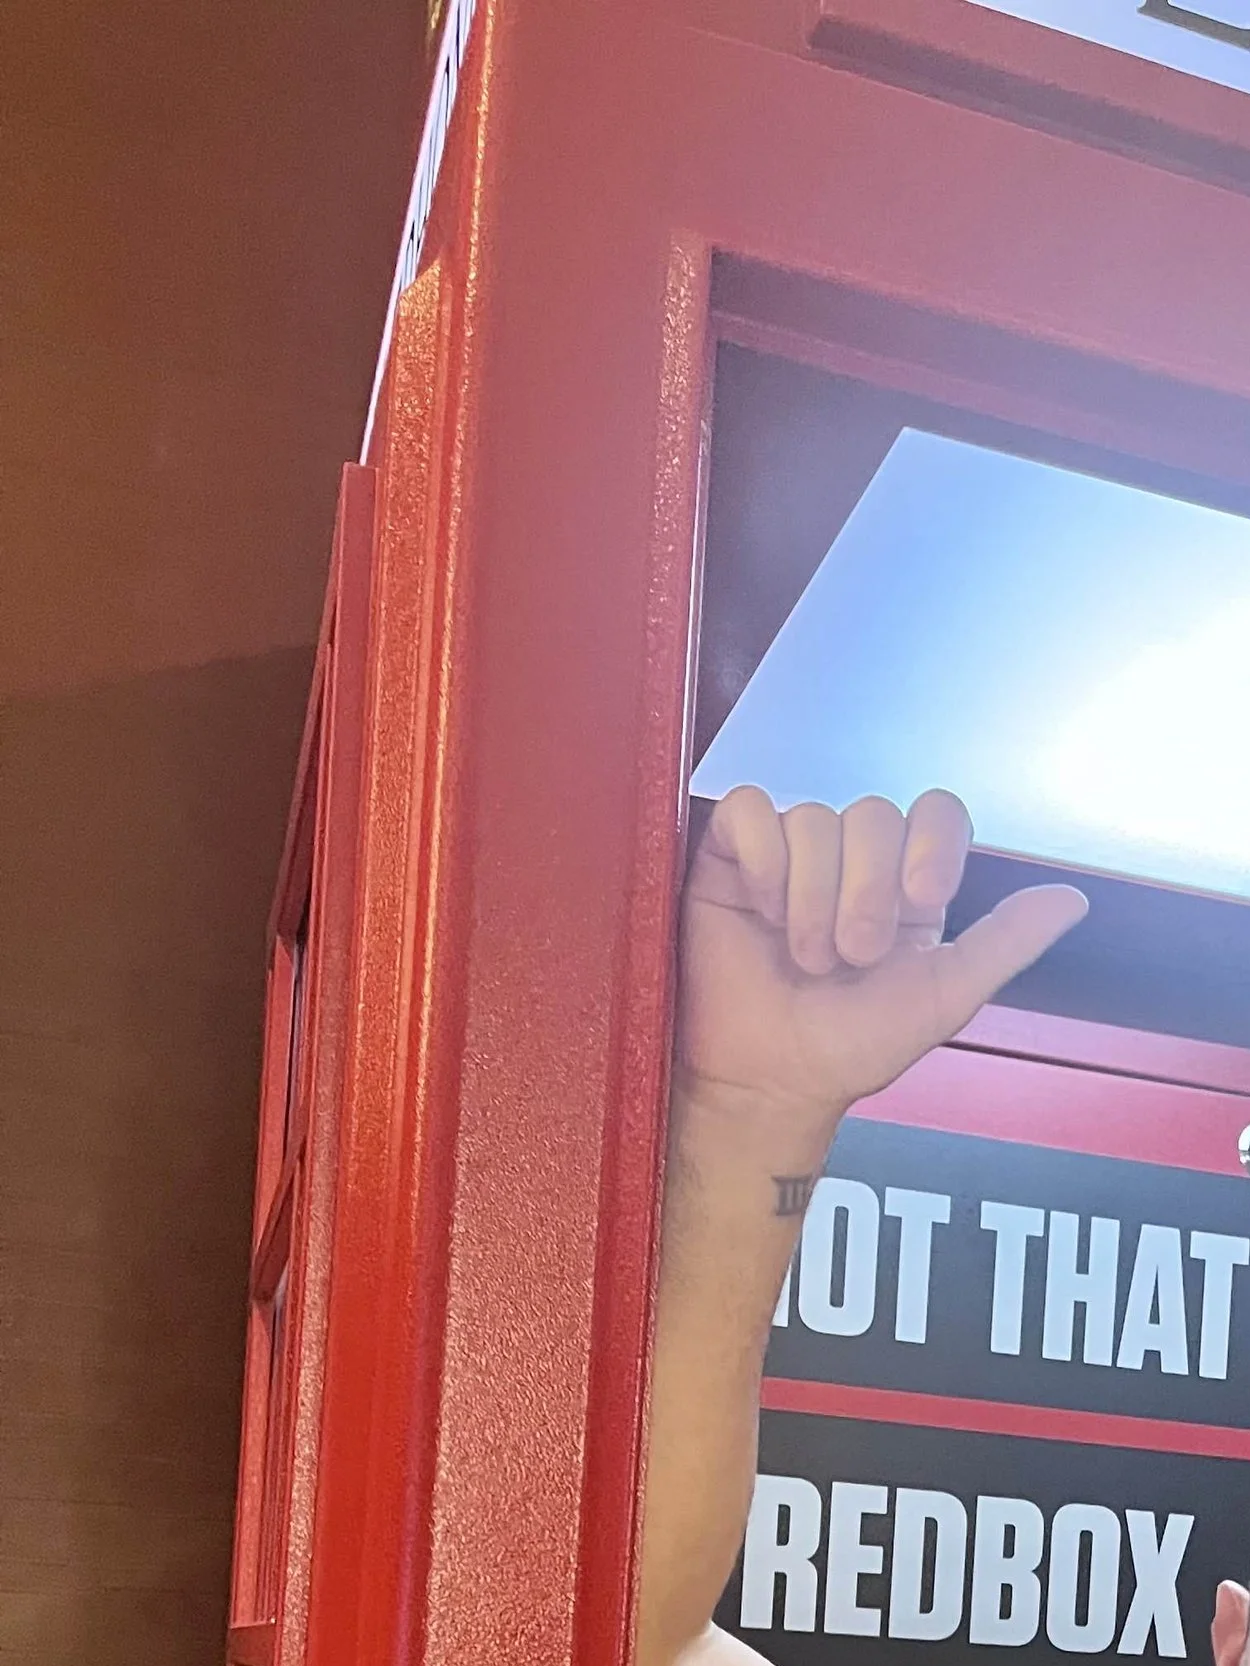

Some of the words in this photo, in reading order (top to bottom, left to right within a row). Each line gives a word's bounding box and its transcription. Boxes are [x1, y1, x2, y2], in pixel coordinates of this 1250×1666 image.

[772, 1177, 951, 1344] OT
[980, 1200, 1250, 1380] THAT
[740, 1474, 1195, 1658] REDBOX
